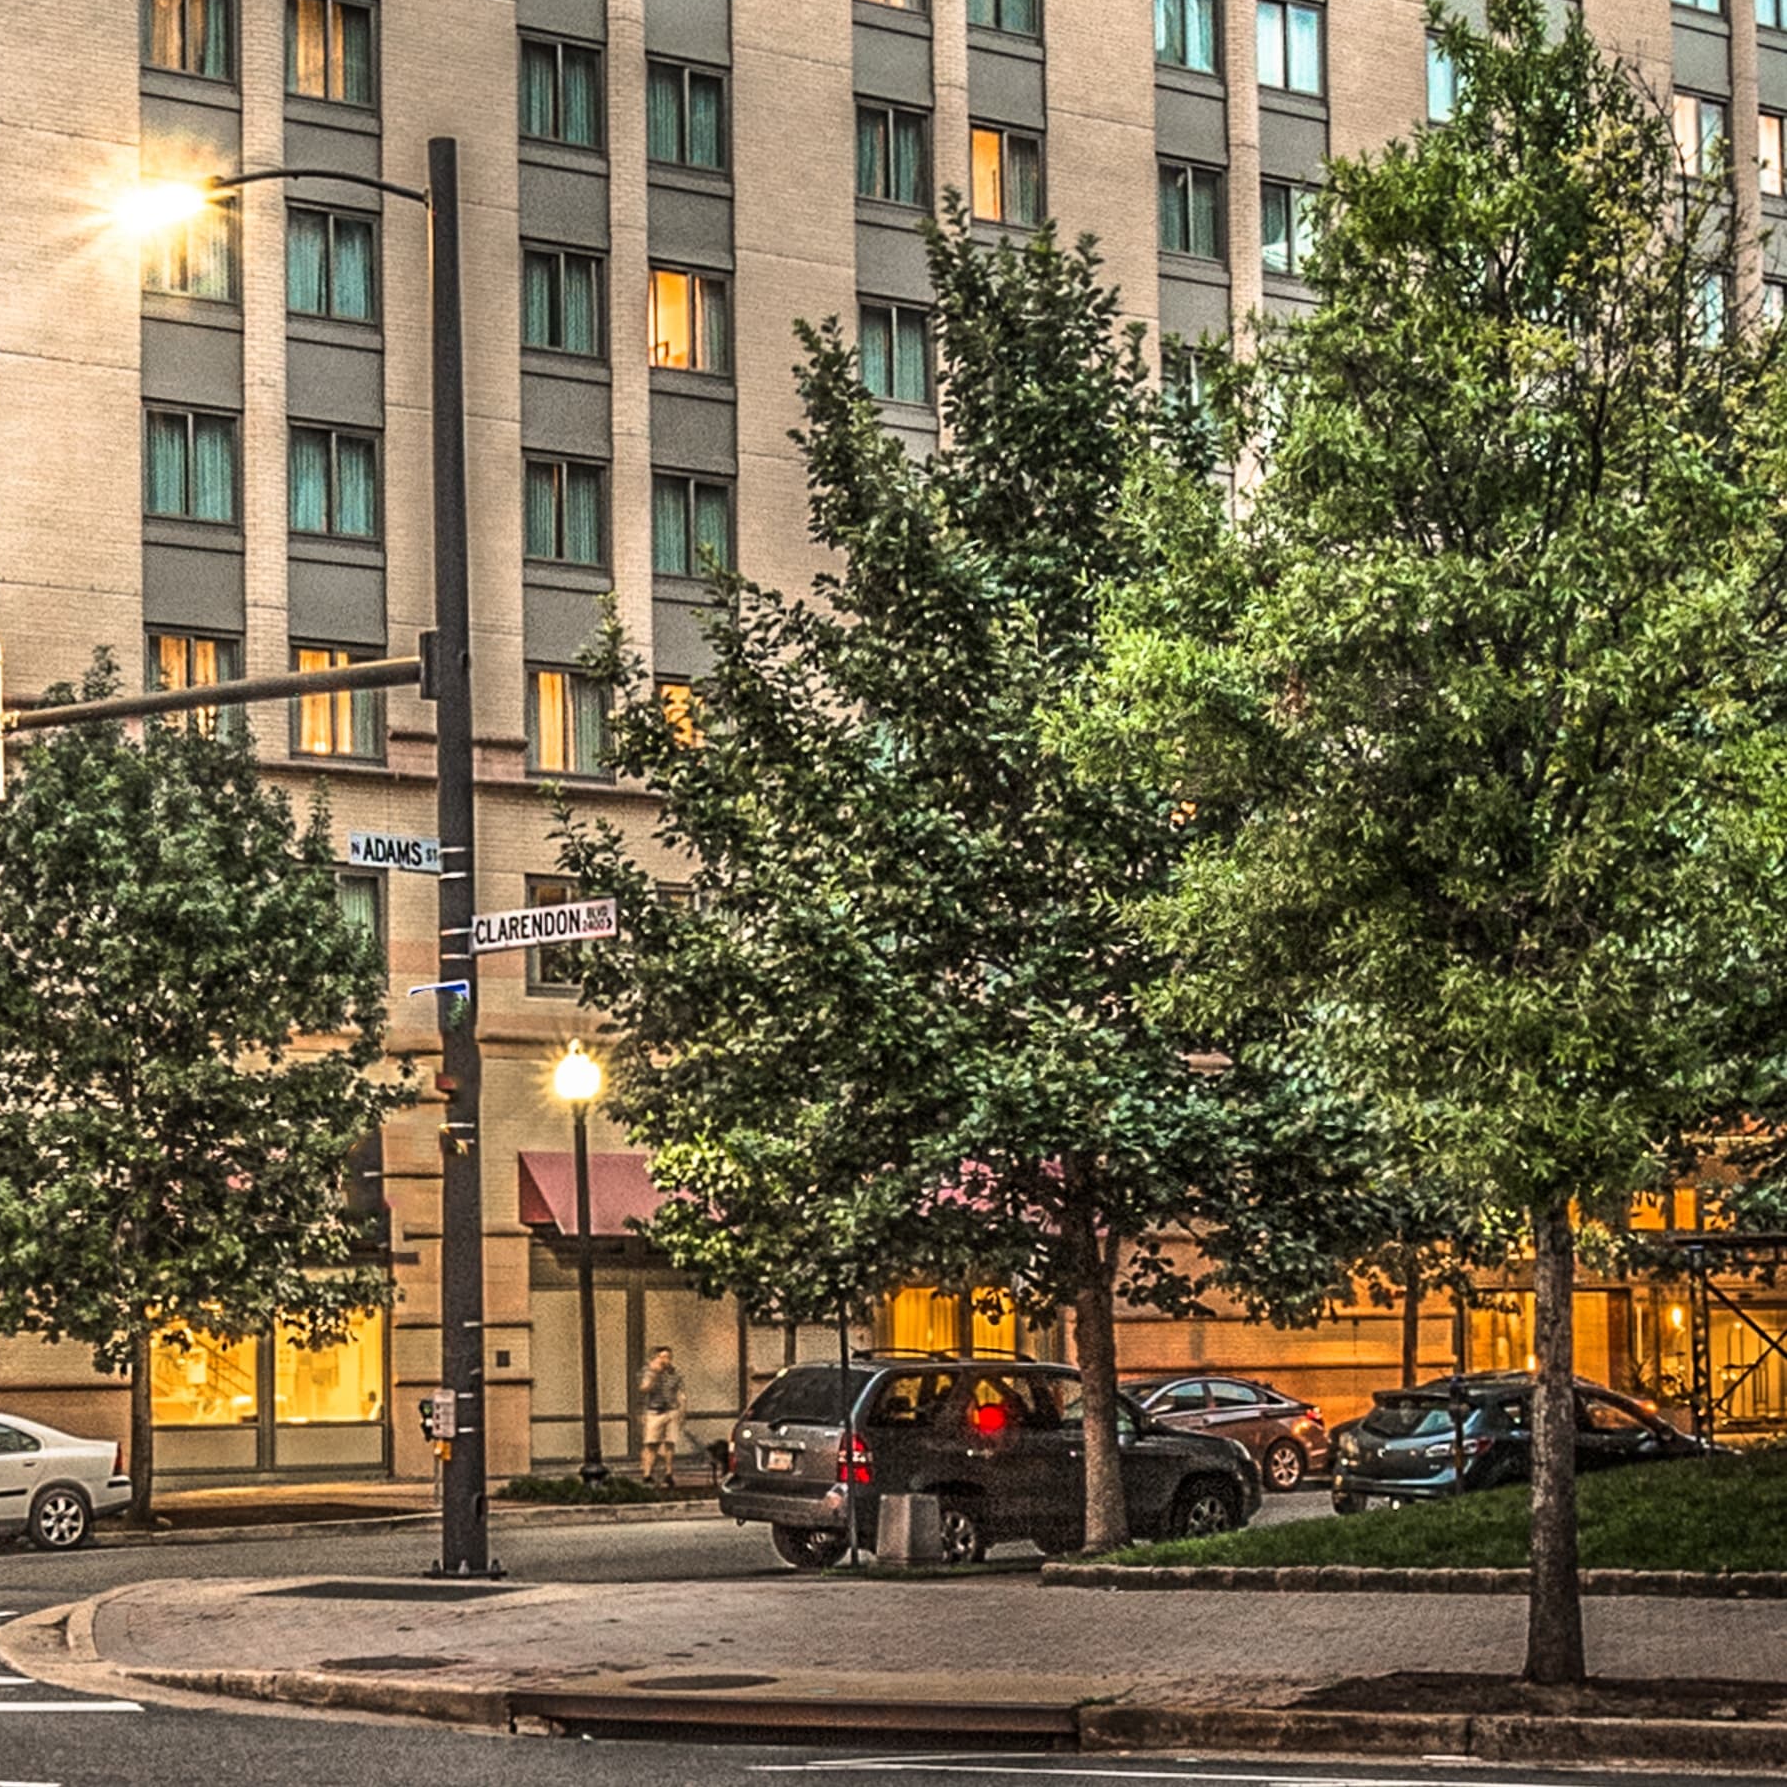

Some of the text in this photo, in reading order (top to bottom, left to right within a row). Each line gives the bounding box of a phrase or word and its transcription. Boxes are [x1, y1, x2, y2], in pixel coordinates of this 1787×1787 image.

[351, 837, 437, 866] N ADAMS ST
[475, 908, 580, 945] CLARENDON
